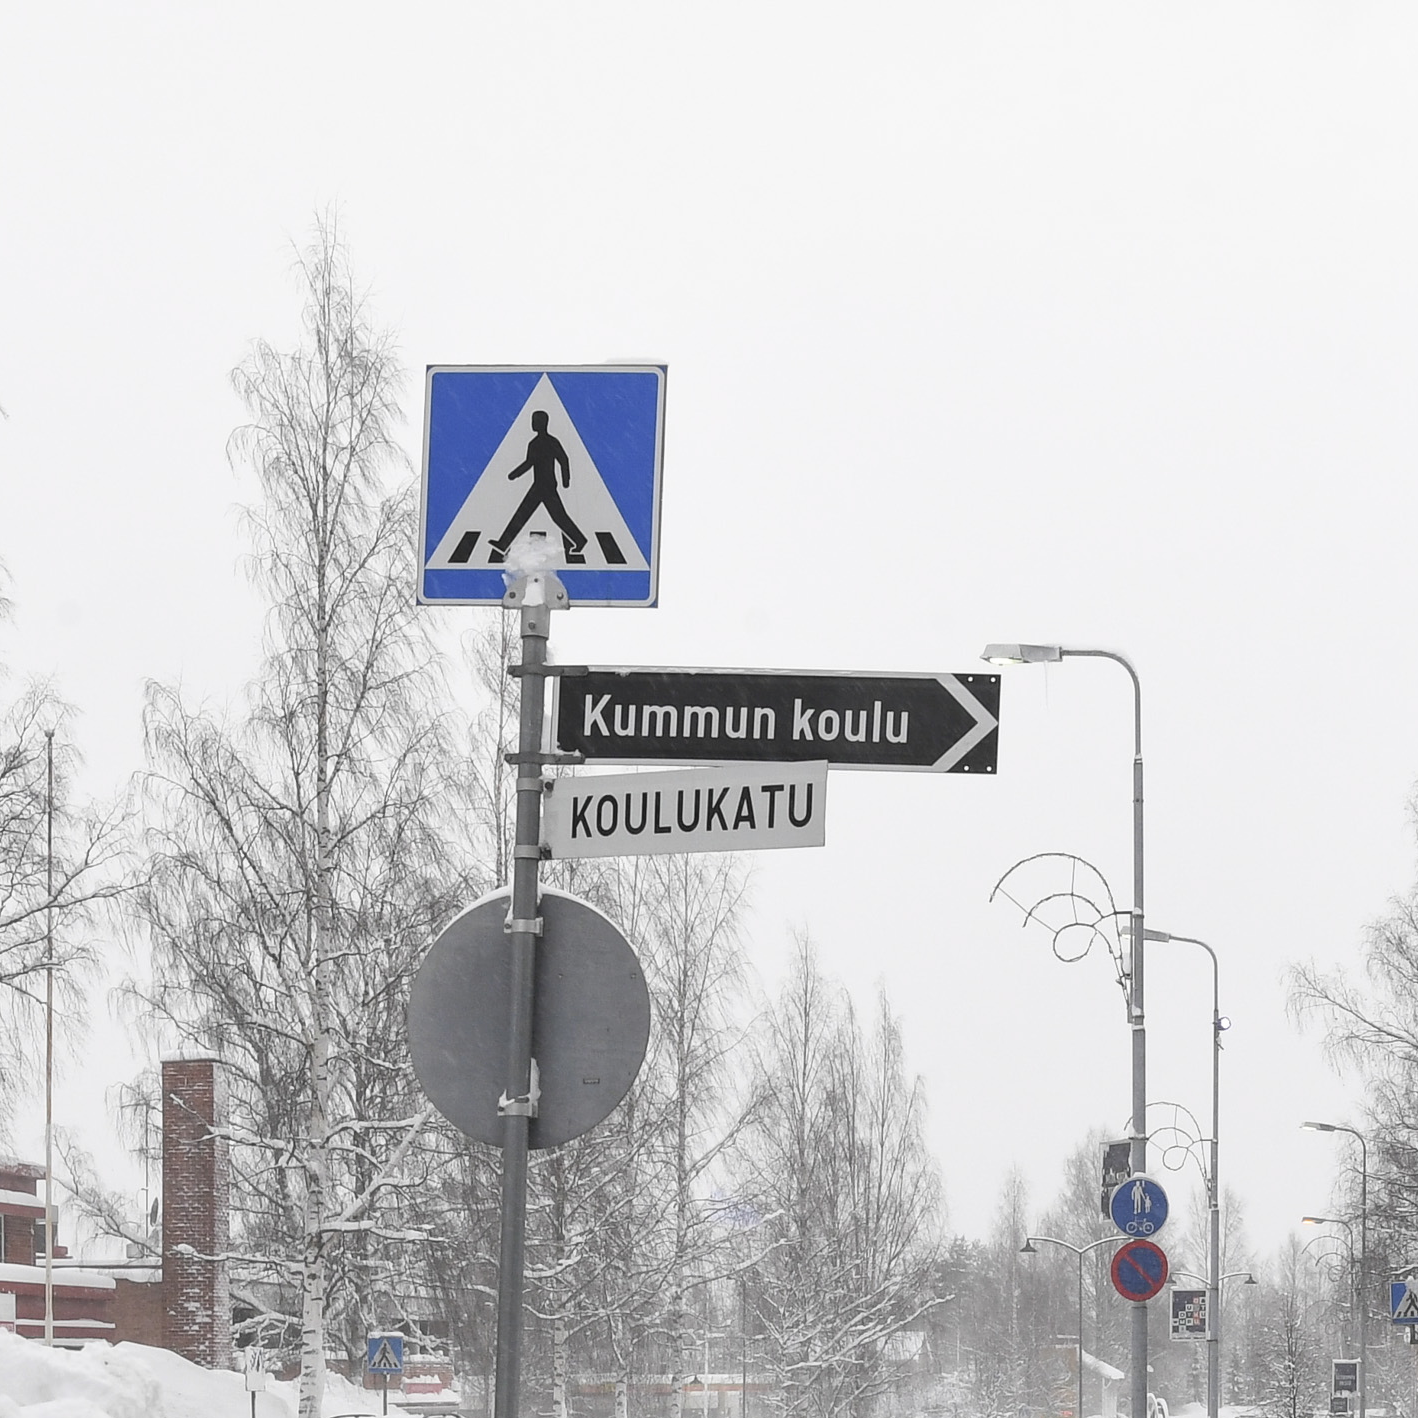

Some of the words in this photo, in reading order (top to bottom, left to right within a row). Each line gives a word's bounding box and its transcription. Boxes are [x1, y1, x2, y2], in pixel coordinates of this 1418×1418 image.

[583, 694, 776, 740] Kummun
[791, 698, 910, 744] koulu
[570, 782, 815, 839] KOULUKATU
